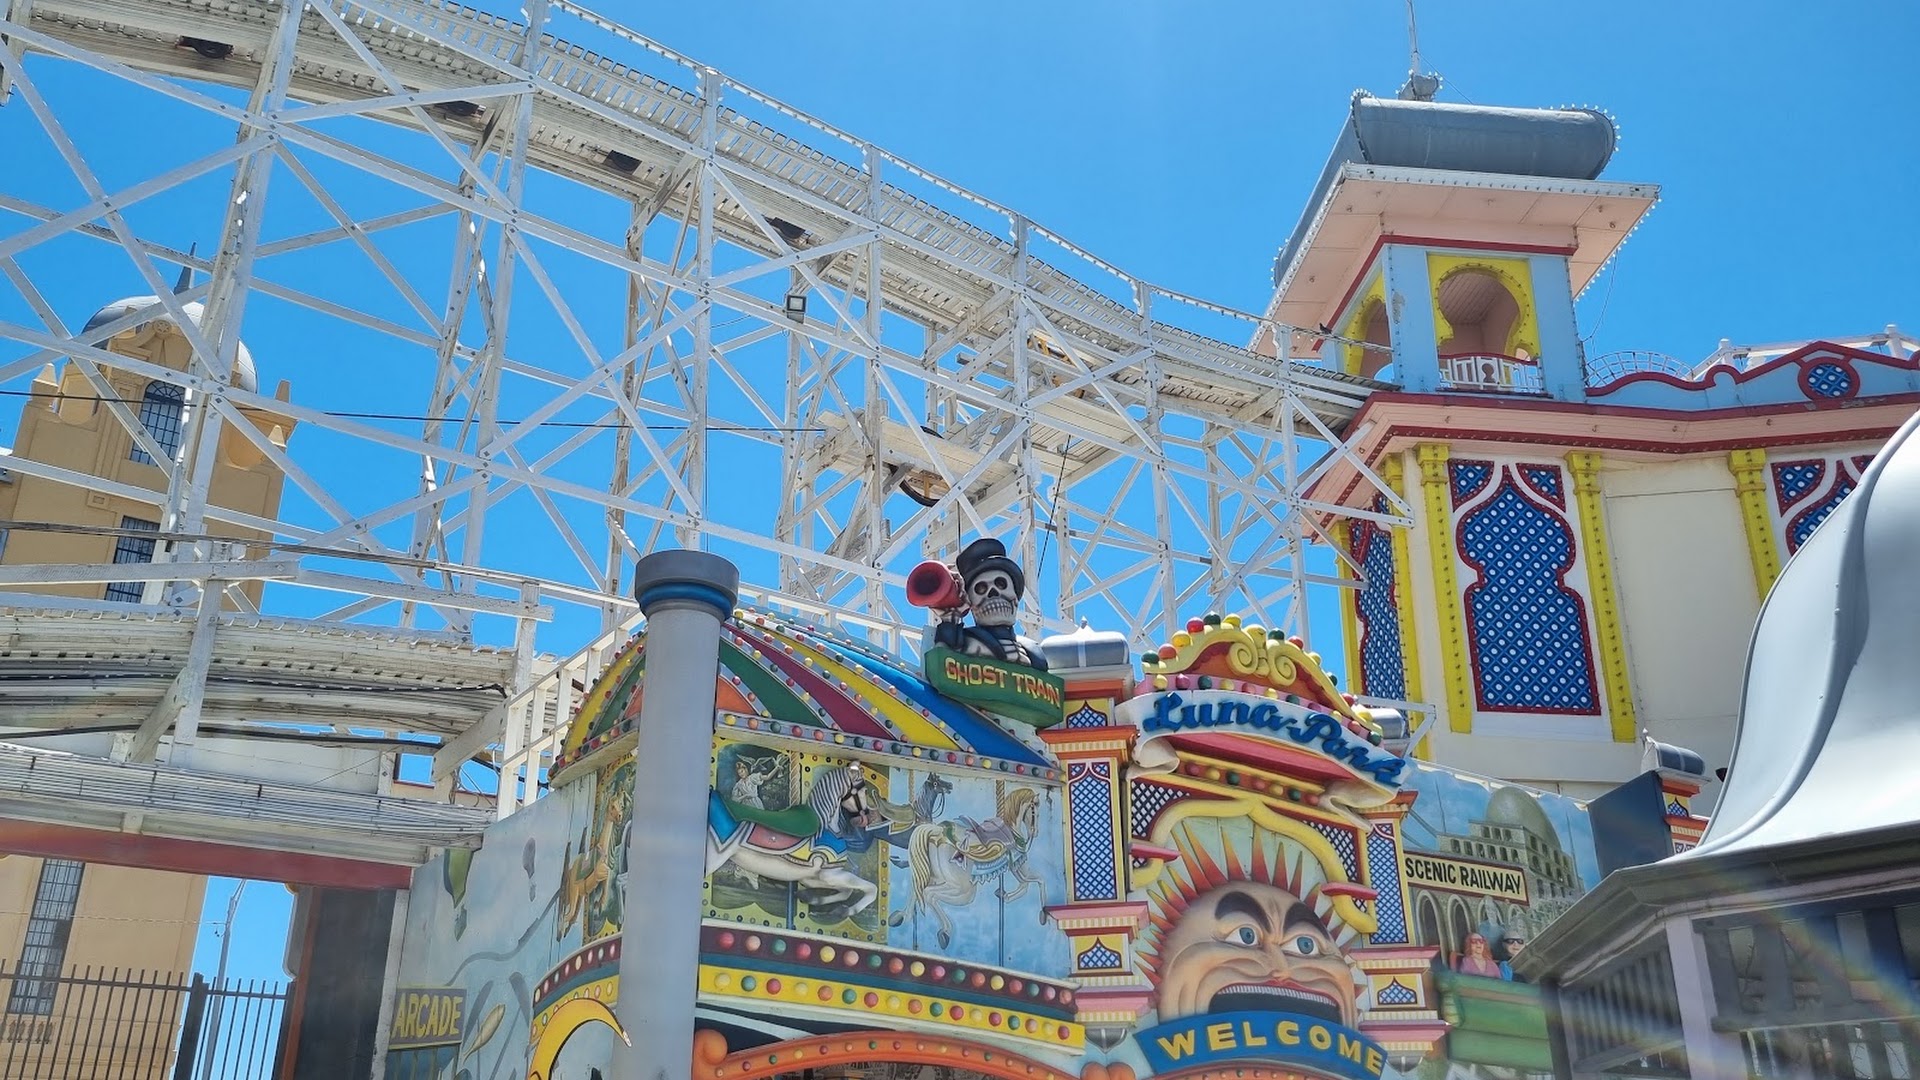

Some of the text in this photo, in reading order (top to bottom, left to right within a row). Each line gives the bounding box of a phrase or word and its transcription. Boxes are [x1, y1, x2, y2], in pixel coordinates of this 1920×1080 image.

[944, 656, 1061, 708] GHOST TRAIN
[1405, 857, 1521, 895] SCENIC RAILWAY
[391, 992, 464, 1038] ARCADE
[1157, 1020, 1384, 1076] WELCOME
